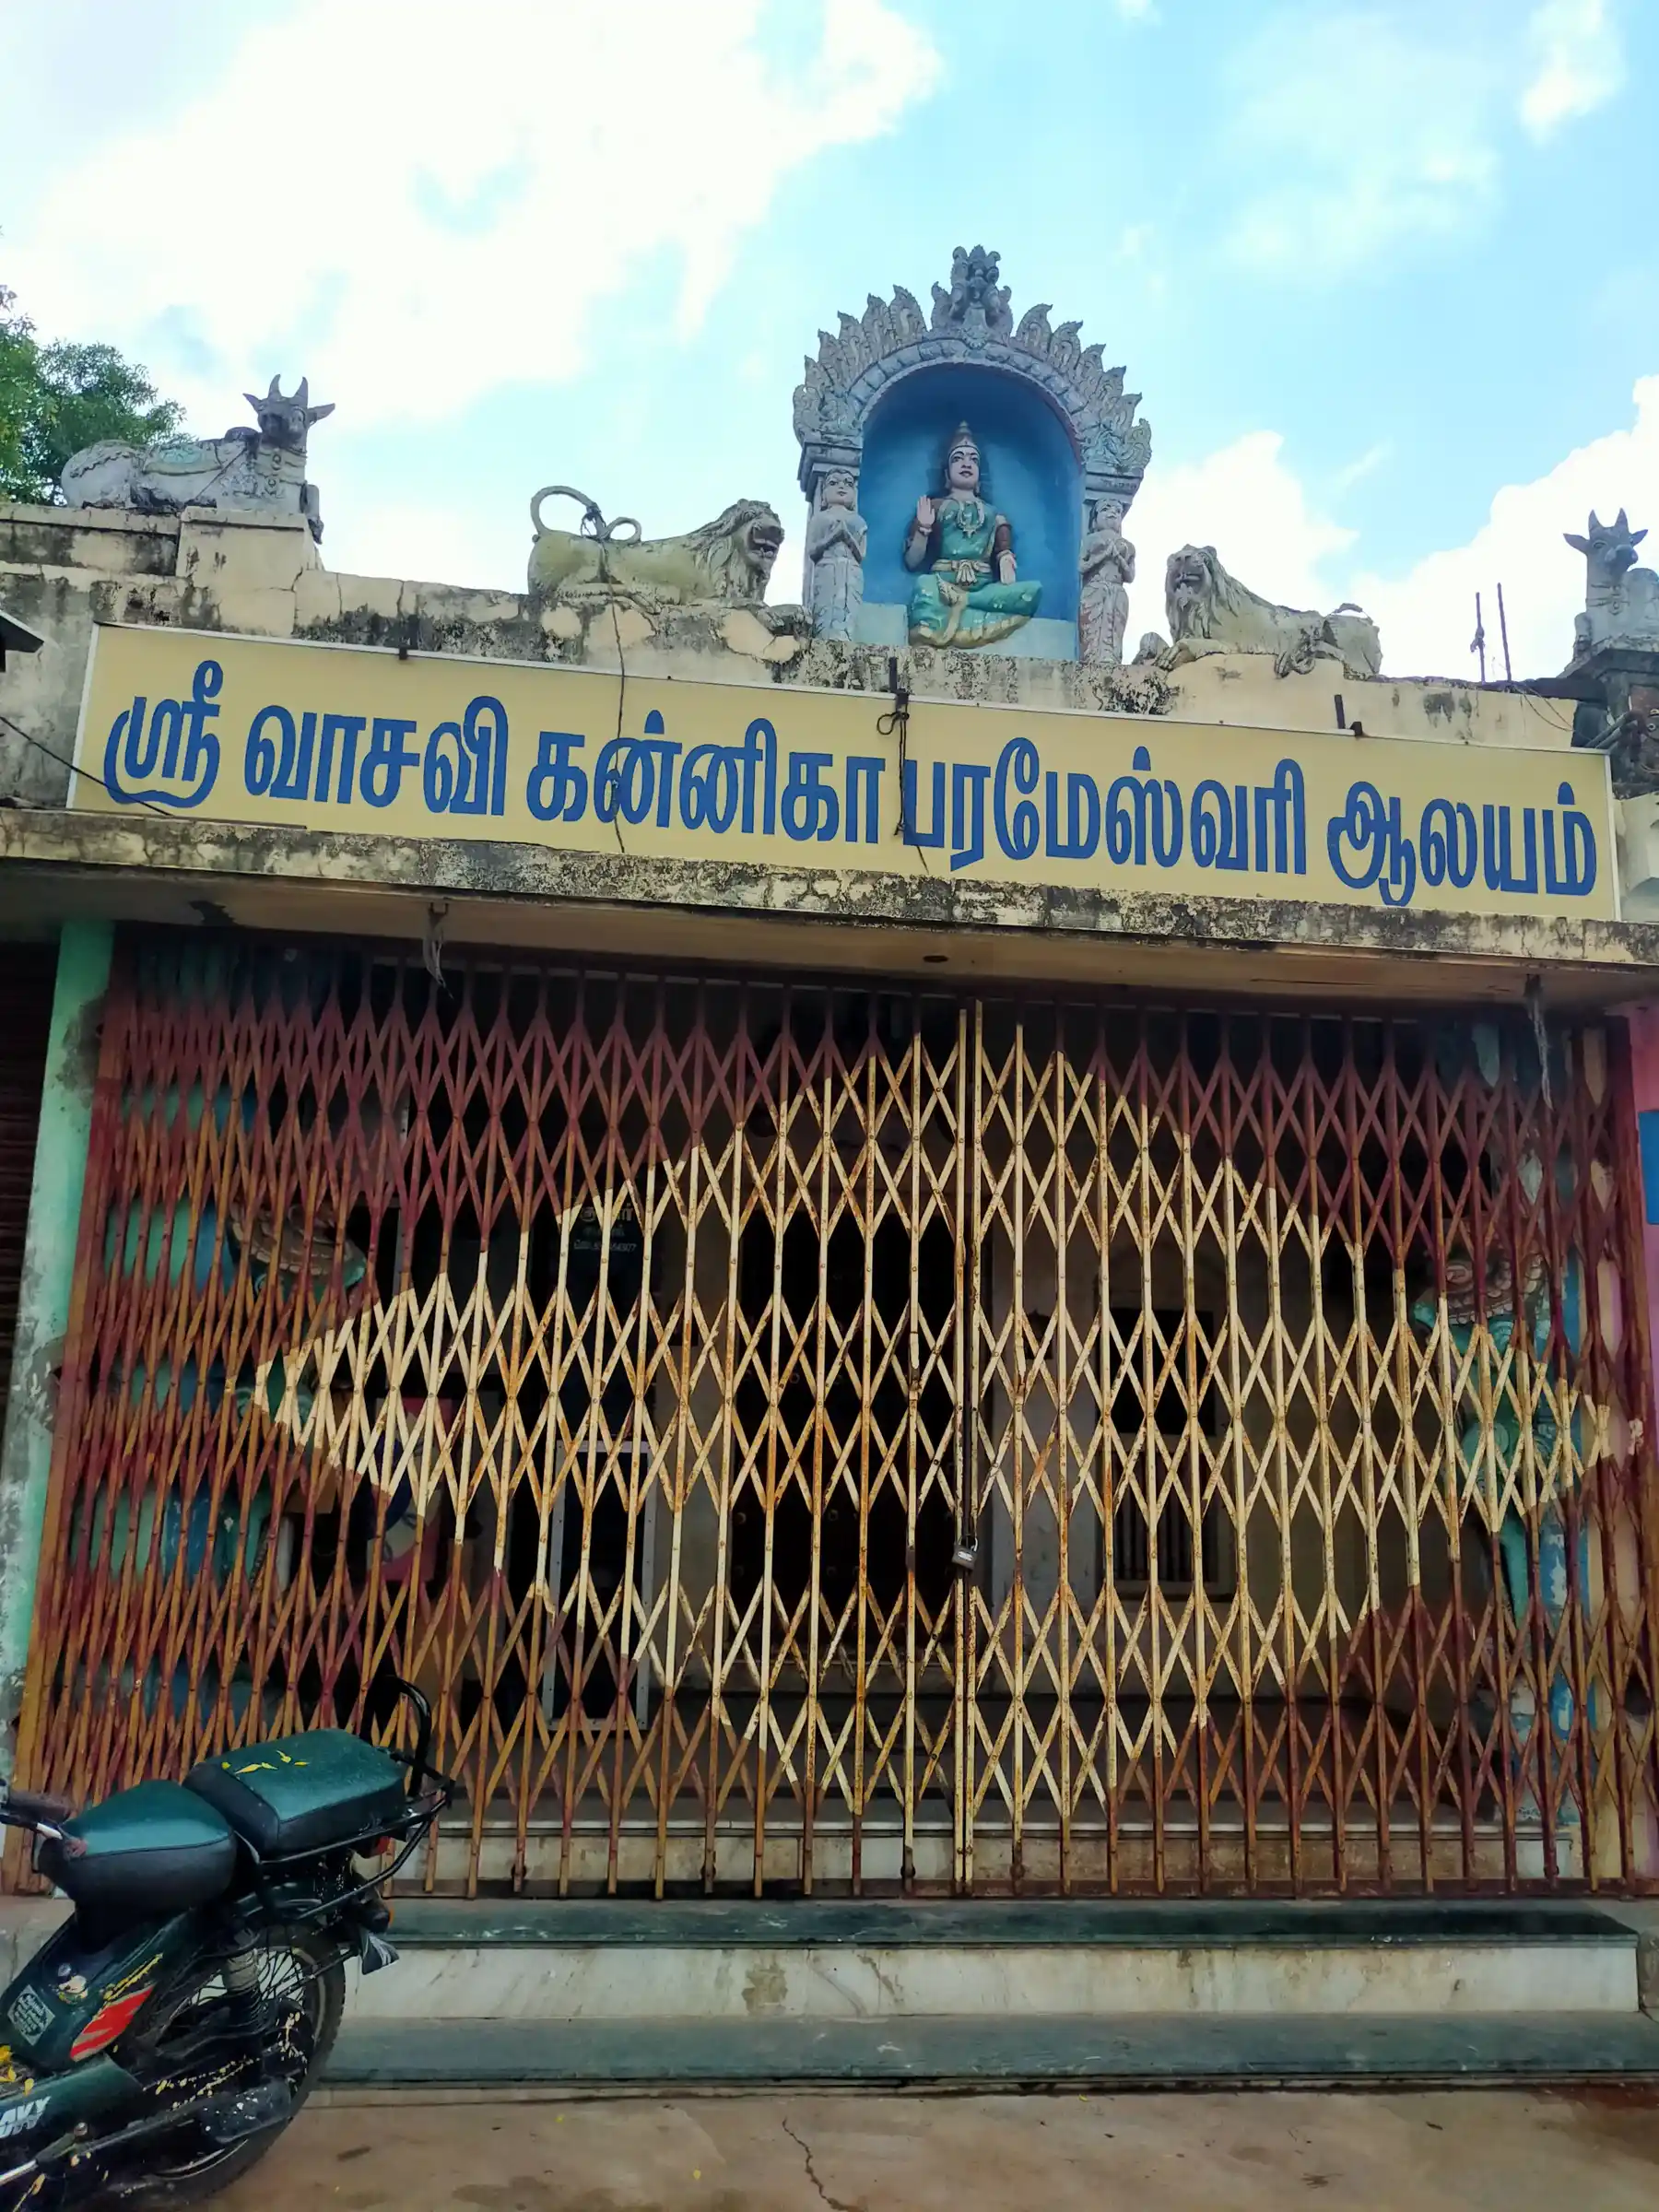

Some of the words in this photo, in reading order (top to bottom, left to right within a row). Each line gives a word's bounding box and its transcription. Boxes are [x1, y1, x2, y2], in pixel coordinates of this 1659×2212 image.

[244, 696, 508, 816] வாசவி
[526, 711, 885, 843] கன்னிகா
[903, 737, 1307, 875] பரமேஸ்வரி
[1327, 782, 1596, 907] ஆலயம்
